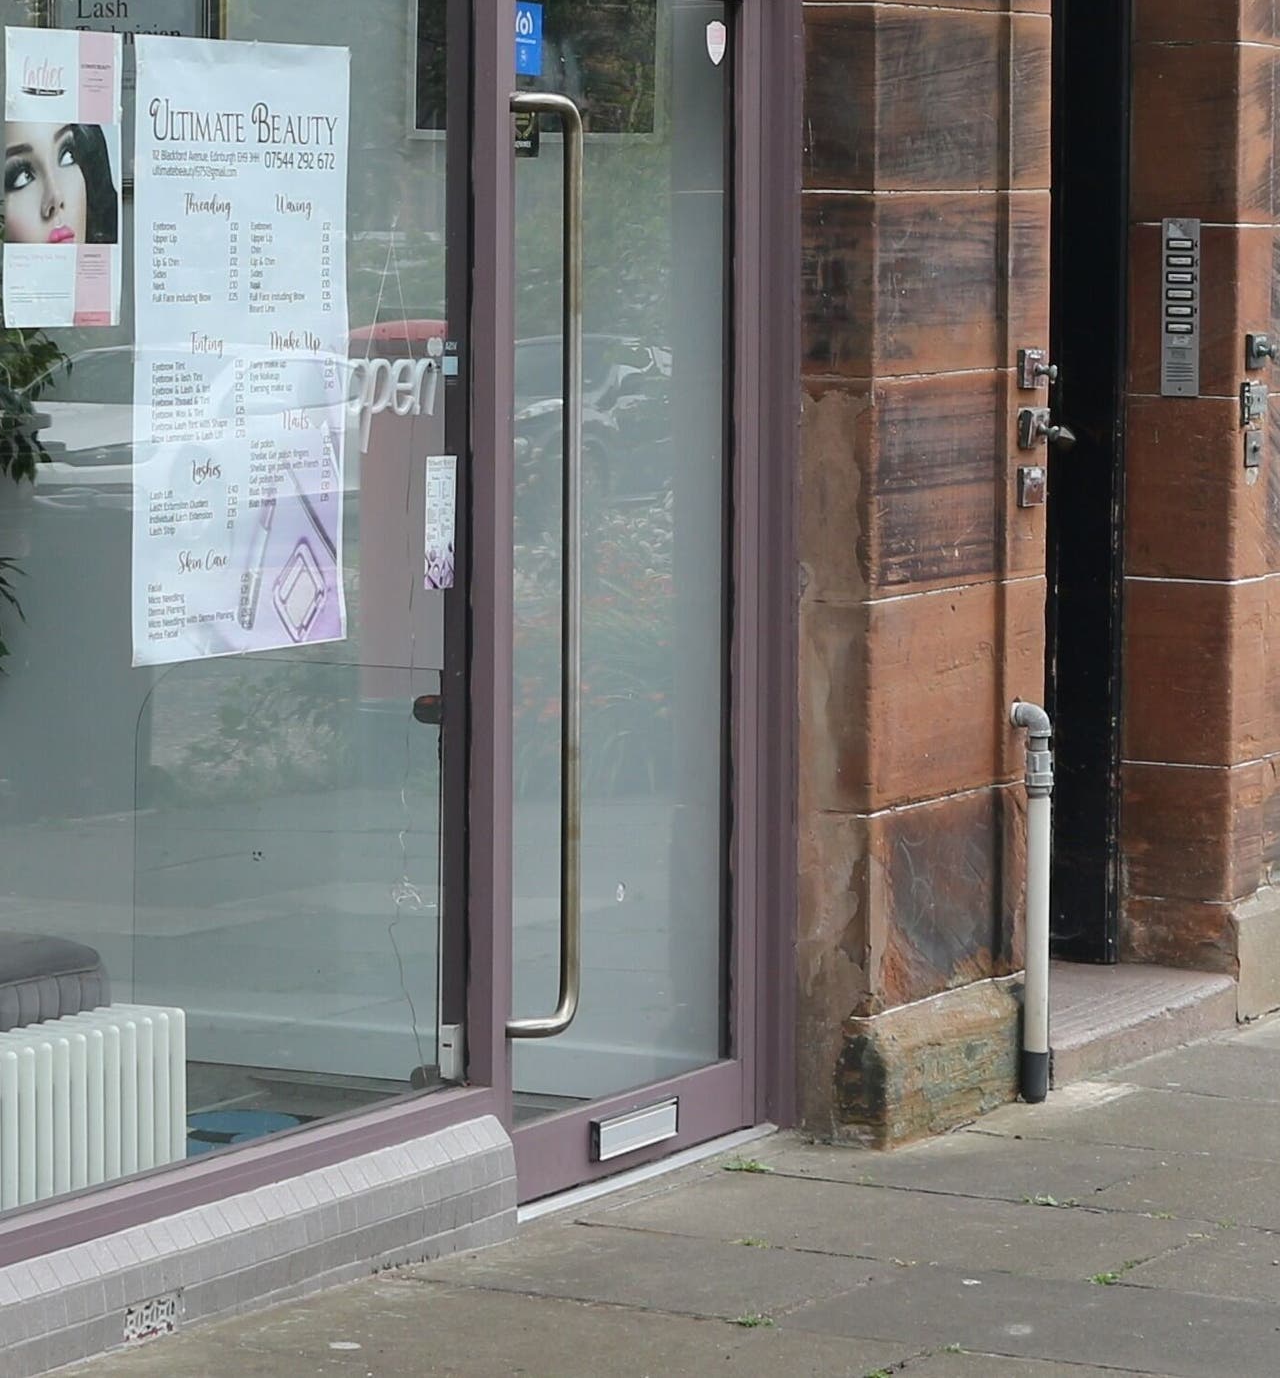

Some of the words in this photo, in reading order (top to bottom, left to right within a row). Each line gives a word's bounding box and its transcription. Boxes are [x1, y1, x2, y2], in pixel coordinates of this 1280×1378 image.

[264, 152, 293, 169] 07544
[297, 152, 314, 169] 292
[318, 153, 335, 170] 672
[185, 193, 231, 221] Threading
[275, 194, 312, 221] Waxing
[269, 331, 301, 351] Make
[304, 331, 321, 355] Up
[178, 550, 201, 574] Skin
[205, 549, 228, 570] Care
